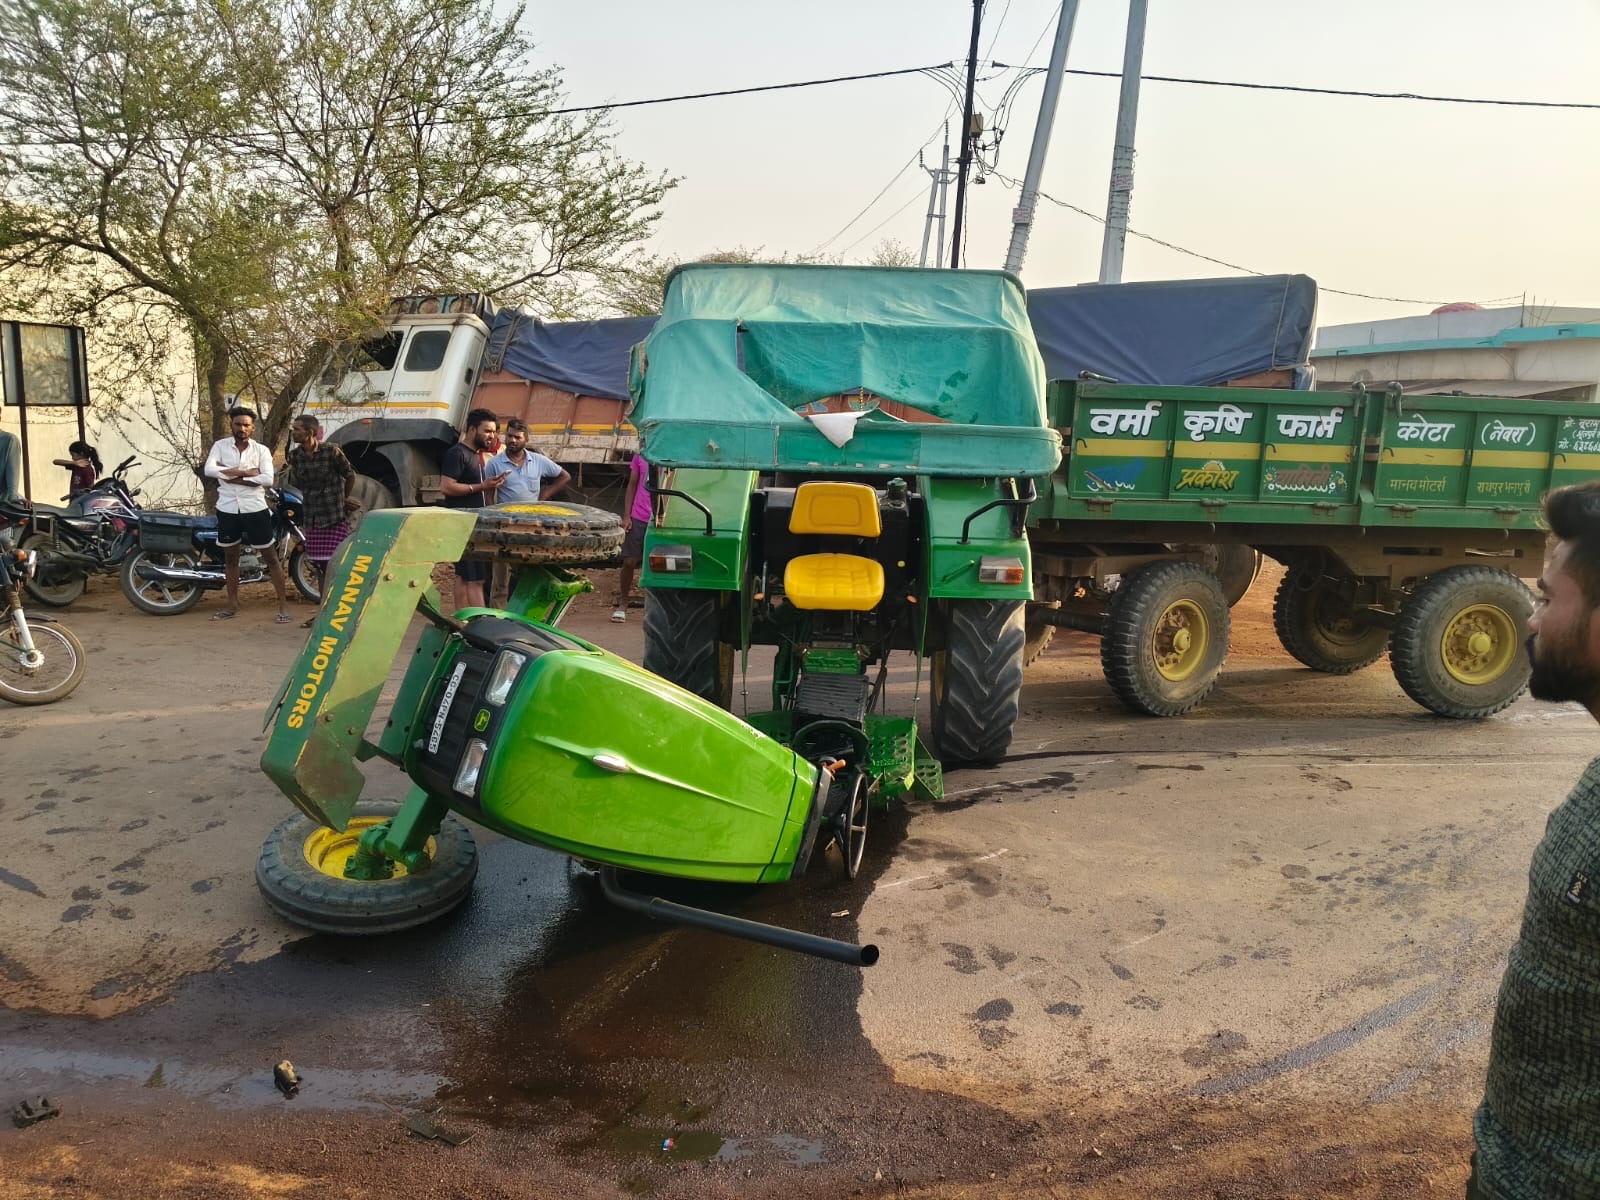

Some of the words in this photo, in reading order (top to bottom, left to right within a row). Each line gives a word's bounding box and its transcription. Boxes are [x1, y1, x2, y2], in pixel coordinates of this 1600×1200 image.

[1089, 400, 1162, 436] वर्मा
[1183, 403, 1254, 441] कृषि
[1275, 406, 1345, 438] फार्म
[1396, 413, 1455, 442] कोटा
[1481, 419, 1536, 446] (नेवरा)
[1175, 468, 1240, 490] प्रकाश
[1390, 479, 1417, 491] मानव
[1419, 475, 1448, 493] मोटर्स
[329, 554, 373, 632] MANAV
[287, 636, 339, 730] MOTORS
